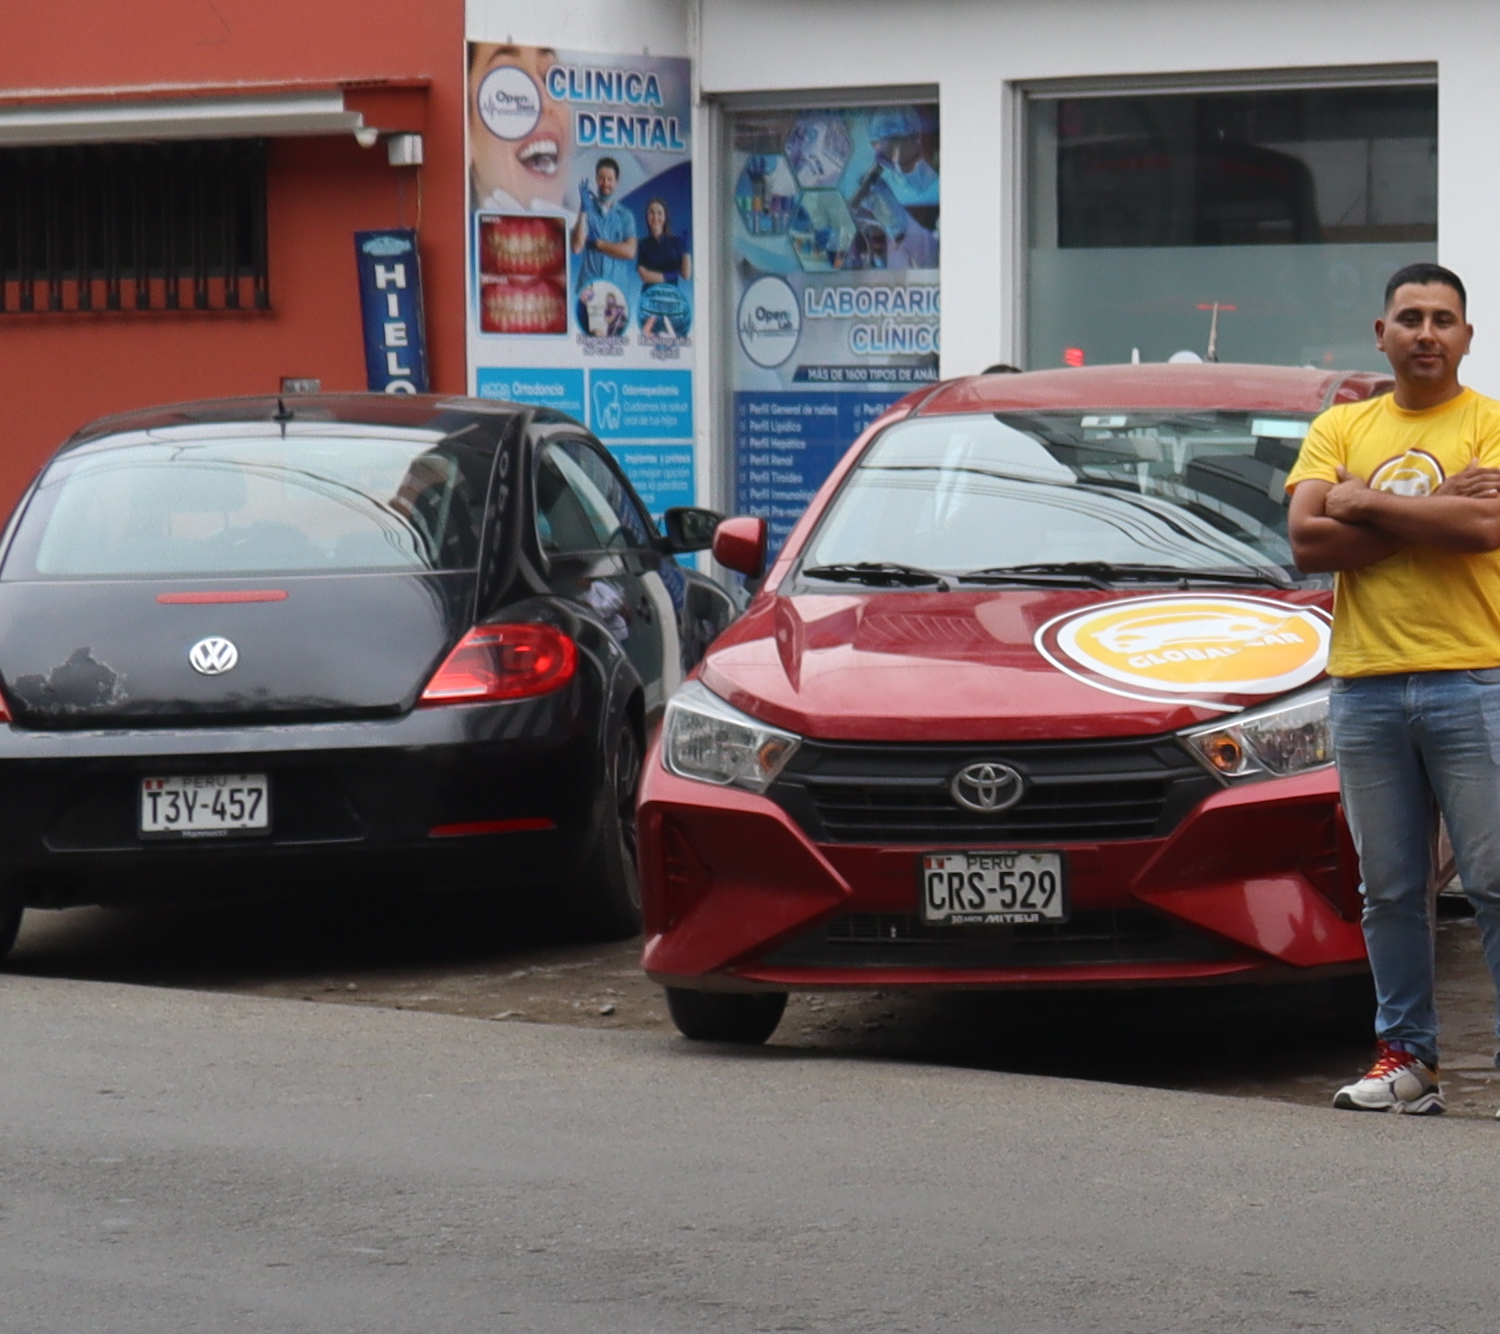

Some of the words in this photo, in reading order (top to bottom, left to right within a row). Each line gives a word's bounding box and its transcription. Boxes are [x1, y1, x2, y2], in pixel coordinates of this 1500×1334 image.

[547, 67, 664, 105] CLINICA
[496, 90, 528, 104] Open
[576, 113, 685, 150] DENTAL
[755, 306, 788, 322] Open
[830, 368, 844, 380] DE
[845, 368, 867, 380] 1600
[868, 368, 897, 380] TIPOS
[899, 368, 912, 380] DE
[1126, 645, 1243, 669] GLOBAL
[183, 777, 227, 788] PERU
[146, 787, 264, 824] T3Y-457
[967, 855, 1016, 870] PERU
[928, 870, 1057, 911] CRS-529
[984, 913, 1040, 924] MITSUI
